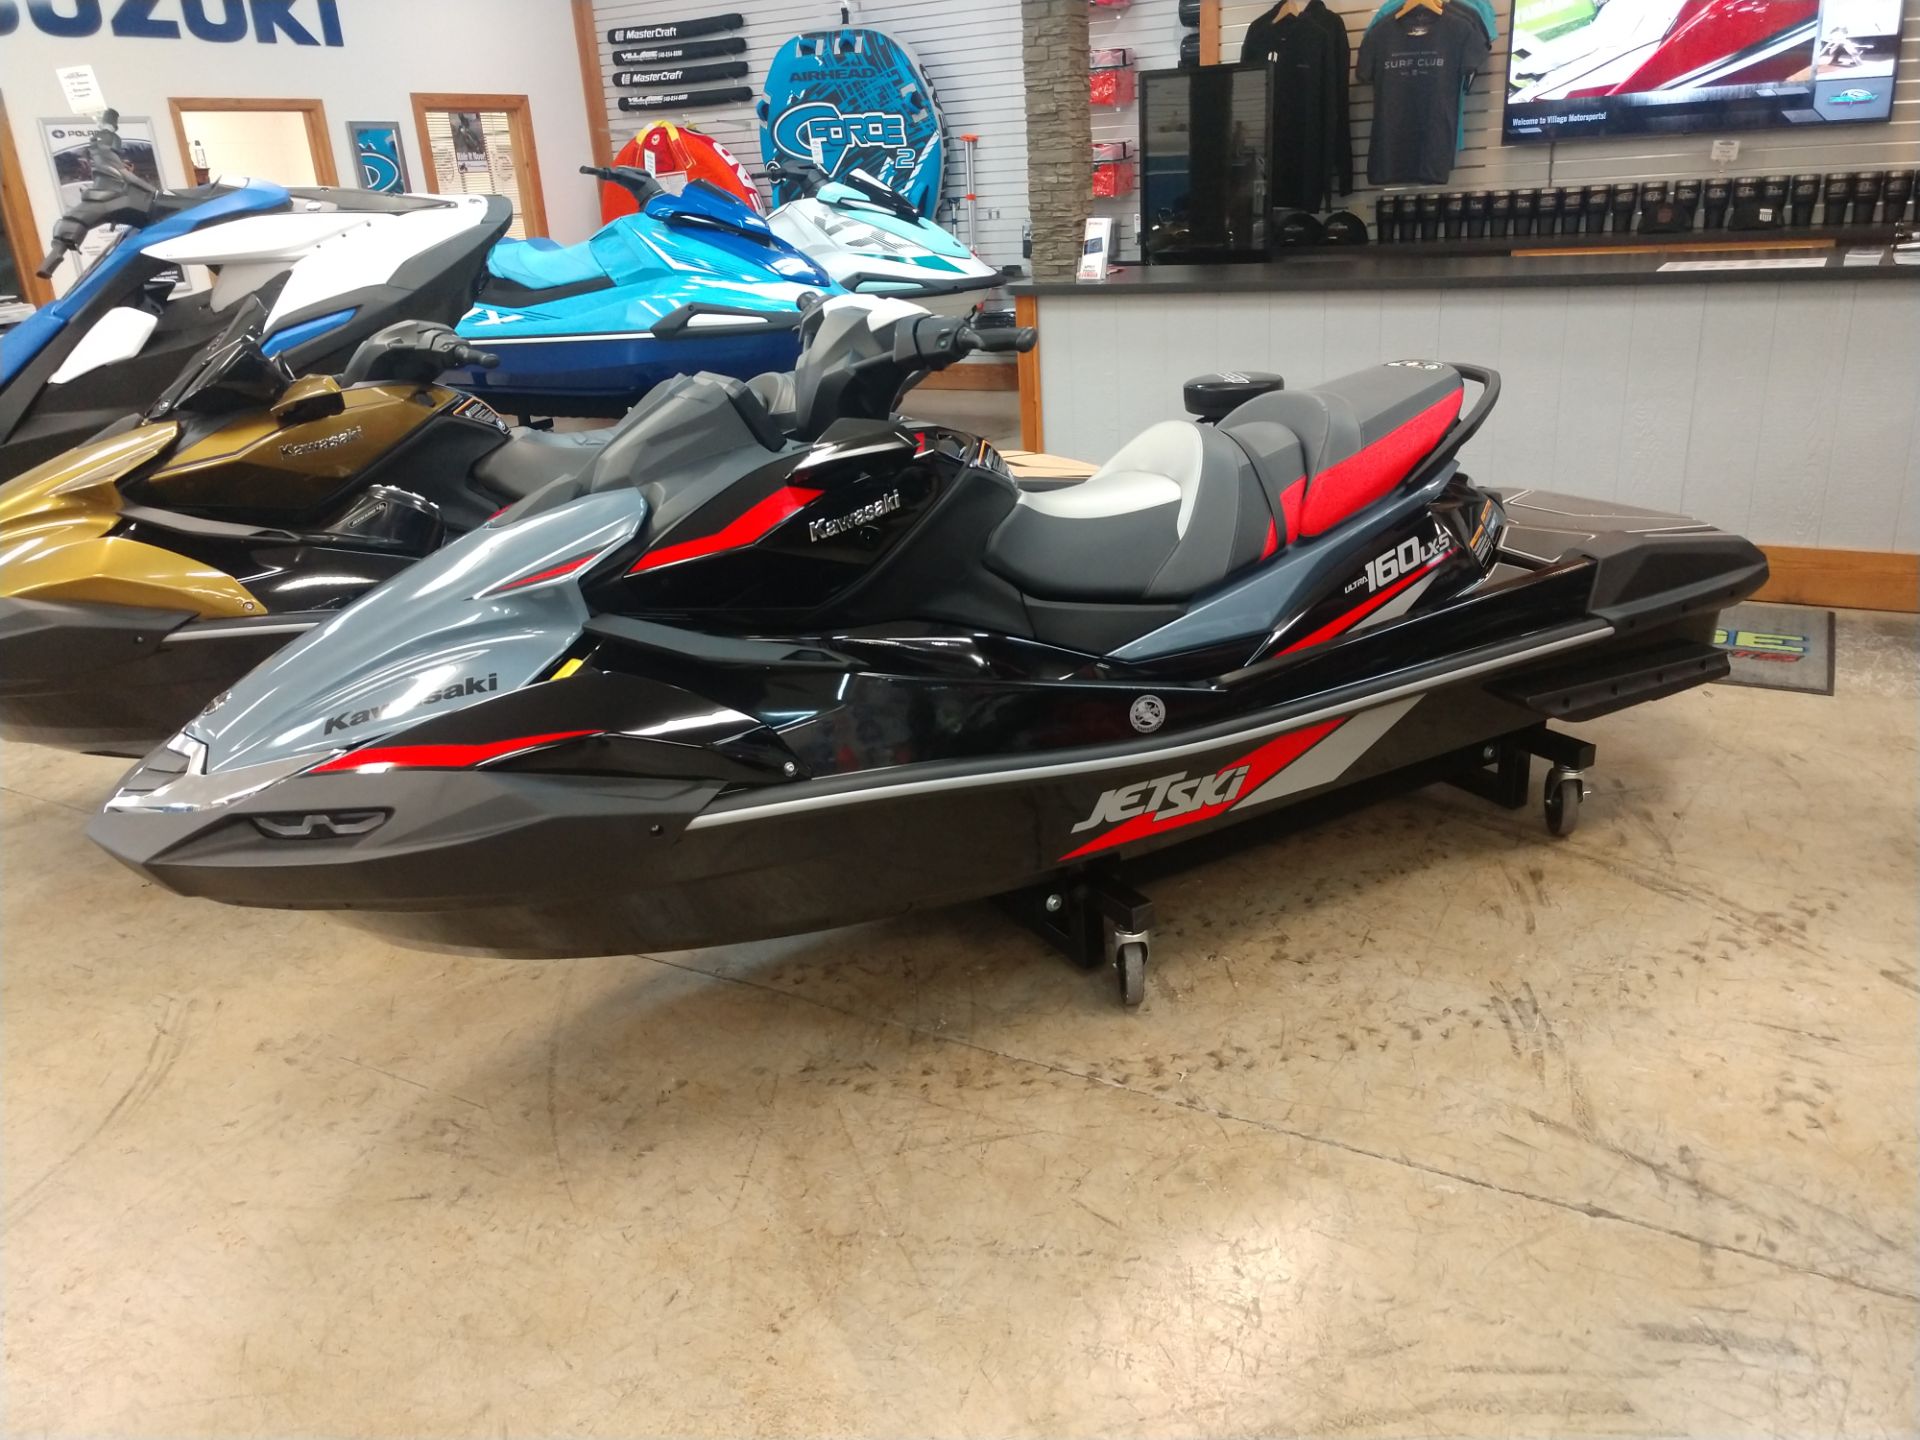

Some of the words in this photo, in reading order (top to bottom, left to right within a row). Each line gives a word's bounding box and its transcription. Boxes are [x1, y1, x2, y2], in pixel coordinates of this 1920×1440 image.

[0, 0, 344, 47] UZUKI
[626, 27, 677, 39] MasterCraft
[1417, 58, 1445, 67] CLUB
[632, 71, 683, 83] MasterCraft
[789, 67, 876, 83] AIRHEAD
[1512, 118, 1538, 126] Welcome
[1547, 115, 1567, 124] Village
[895, 148, 916, 168] 2
[279, 425, 362, 457] Kawasaki
[808, 488, 901, 543] Kawasaki
[1344, 575, 1369, 594] ULTRA
[1365, 535, 1421, 593] 160
